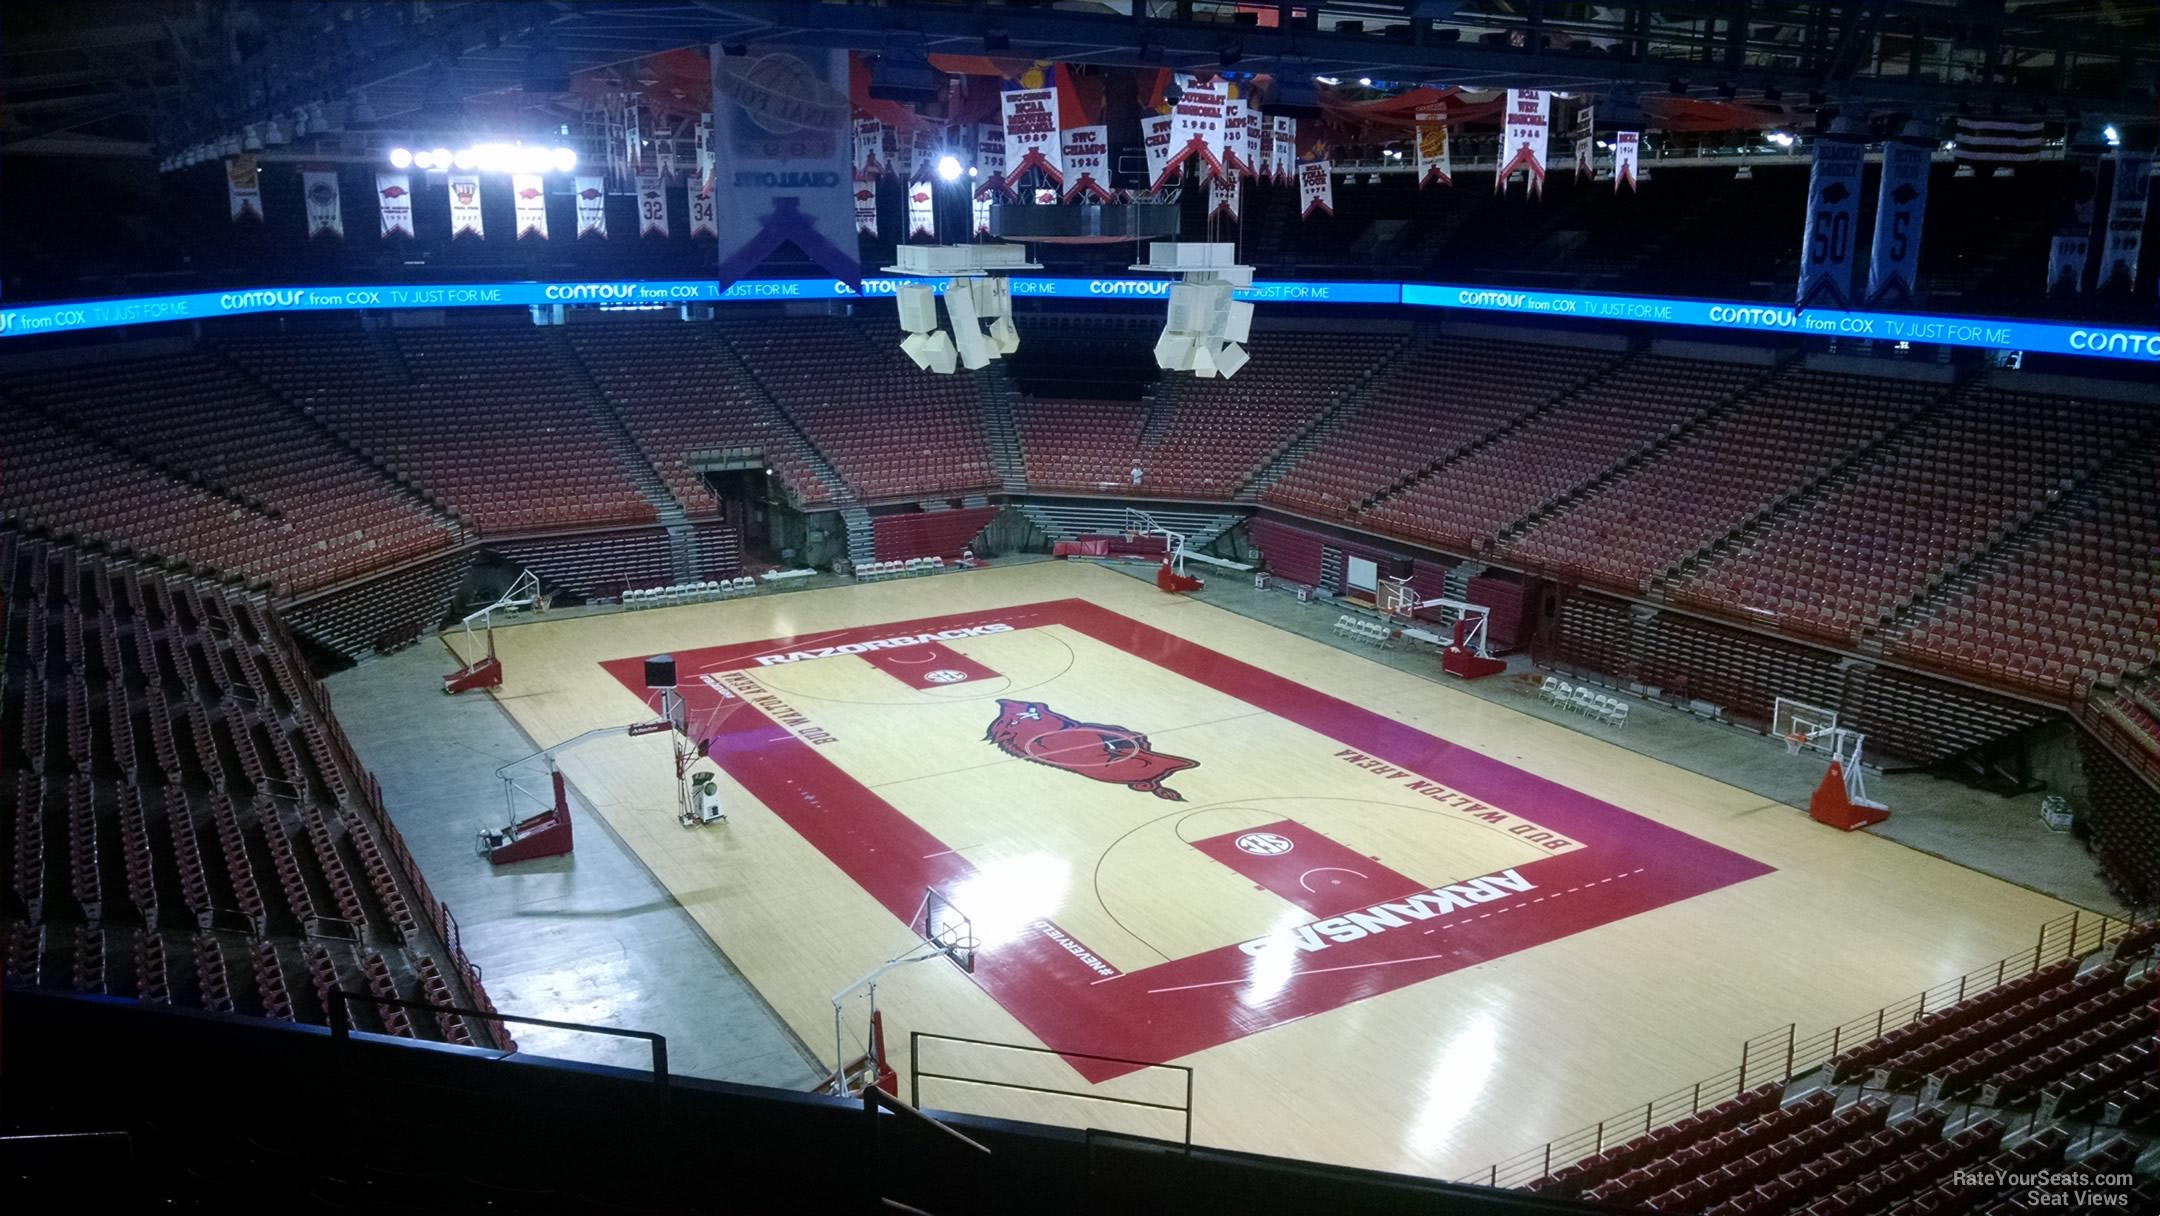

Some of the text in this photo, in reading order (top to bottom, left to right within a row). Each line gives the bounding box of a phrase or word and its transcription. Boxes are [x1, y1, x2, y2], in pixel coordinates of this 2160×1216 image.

[1014, 101, 1045, 114] NCAA
[1182, 119, 1216, 130] 1988
[1017, 133, 1048, 143] 1989
[1072, 132, 1096, 143] SWC
[1063, 144, 1106, 155] CHAMPS
[455, 183, 475, 194] NIT
[643, 201, 663, 221] 32
[693, 202, 714, 222] 34
[1812, 211, 1850, 264] 50
[1890, 211, 1911, 262] 5
[309, 292, 343, 305] from
[346, 292, 380, 305] COX
[391, 291, 409, 303] TV
[411, 290, 445, 303] JUST
[448, 289, 478, 302] FOR
[480, 289, 501, 302] ME
[640, 286, 667, 298] from
[670, 286, 699, 298] COX
[725, 284, 752, 297] JUST
[755, 284, 780, 296] FOR
[782, 283, 800, 295] ME
[1013, 282, 1037, 294] FOR
[1039, 282, 1056, 294] ME
[1253, 285, 1280, 298] JUST
[1284, 286, 1308, 298] FOR
[1311, 287, 1329, 298] ME
[21, 314, 51, 329] from
[55, 311, 86, 326] COX
[94, 308, 110, 321] TV
[113, 304, 141, 321] JUST
[144, 303, 168, 318] FOR
[169, 301, 189, 316] ME
[1528, 296, 1550, 310] from
[1552, 299, 1576, 312] COX
[1584, 301, 1598, 313] TV
[1600, 302, 1626, 316] JUST
[1627, 303, 1652, 318] FOR
[1654, 305, 1672, 319] ME
[1805, 315, 1836, 331] from
[1840, 318, 1874, 333] COX
[1886, 320, 1904, 335] TV
[1907, 322, 1943, 338] JUST
[1947, 325, 1982, 342] FOR
[1985, 328, 2011, 344] ME
[755, 623, 1015, 667] RAZORBACKS
[719, 671, 767, 695] ARENA
[925, 669, 967, 682] SEC
[752, 697, 811, 728] WALTON
[798, 726, 839, 746] BUD
[1333, 748, 1572, 850] BUD WALTON ARENA
[1237, 833, 1293, 855] SEC
[1238, 868, 1539, 957] ARKANSAS
[1034, 920, 1114, 976] #NEVERYIELD
